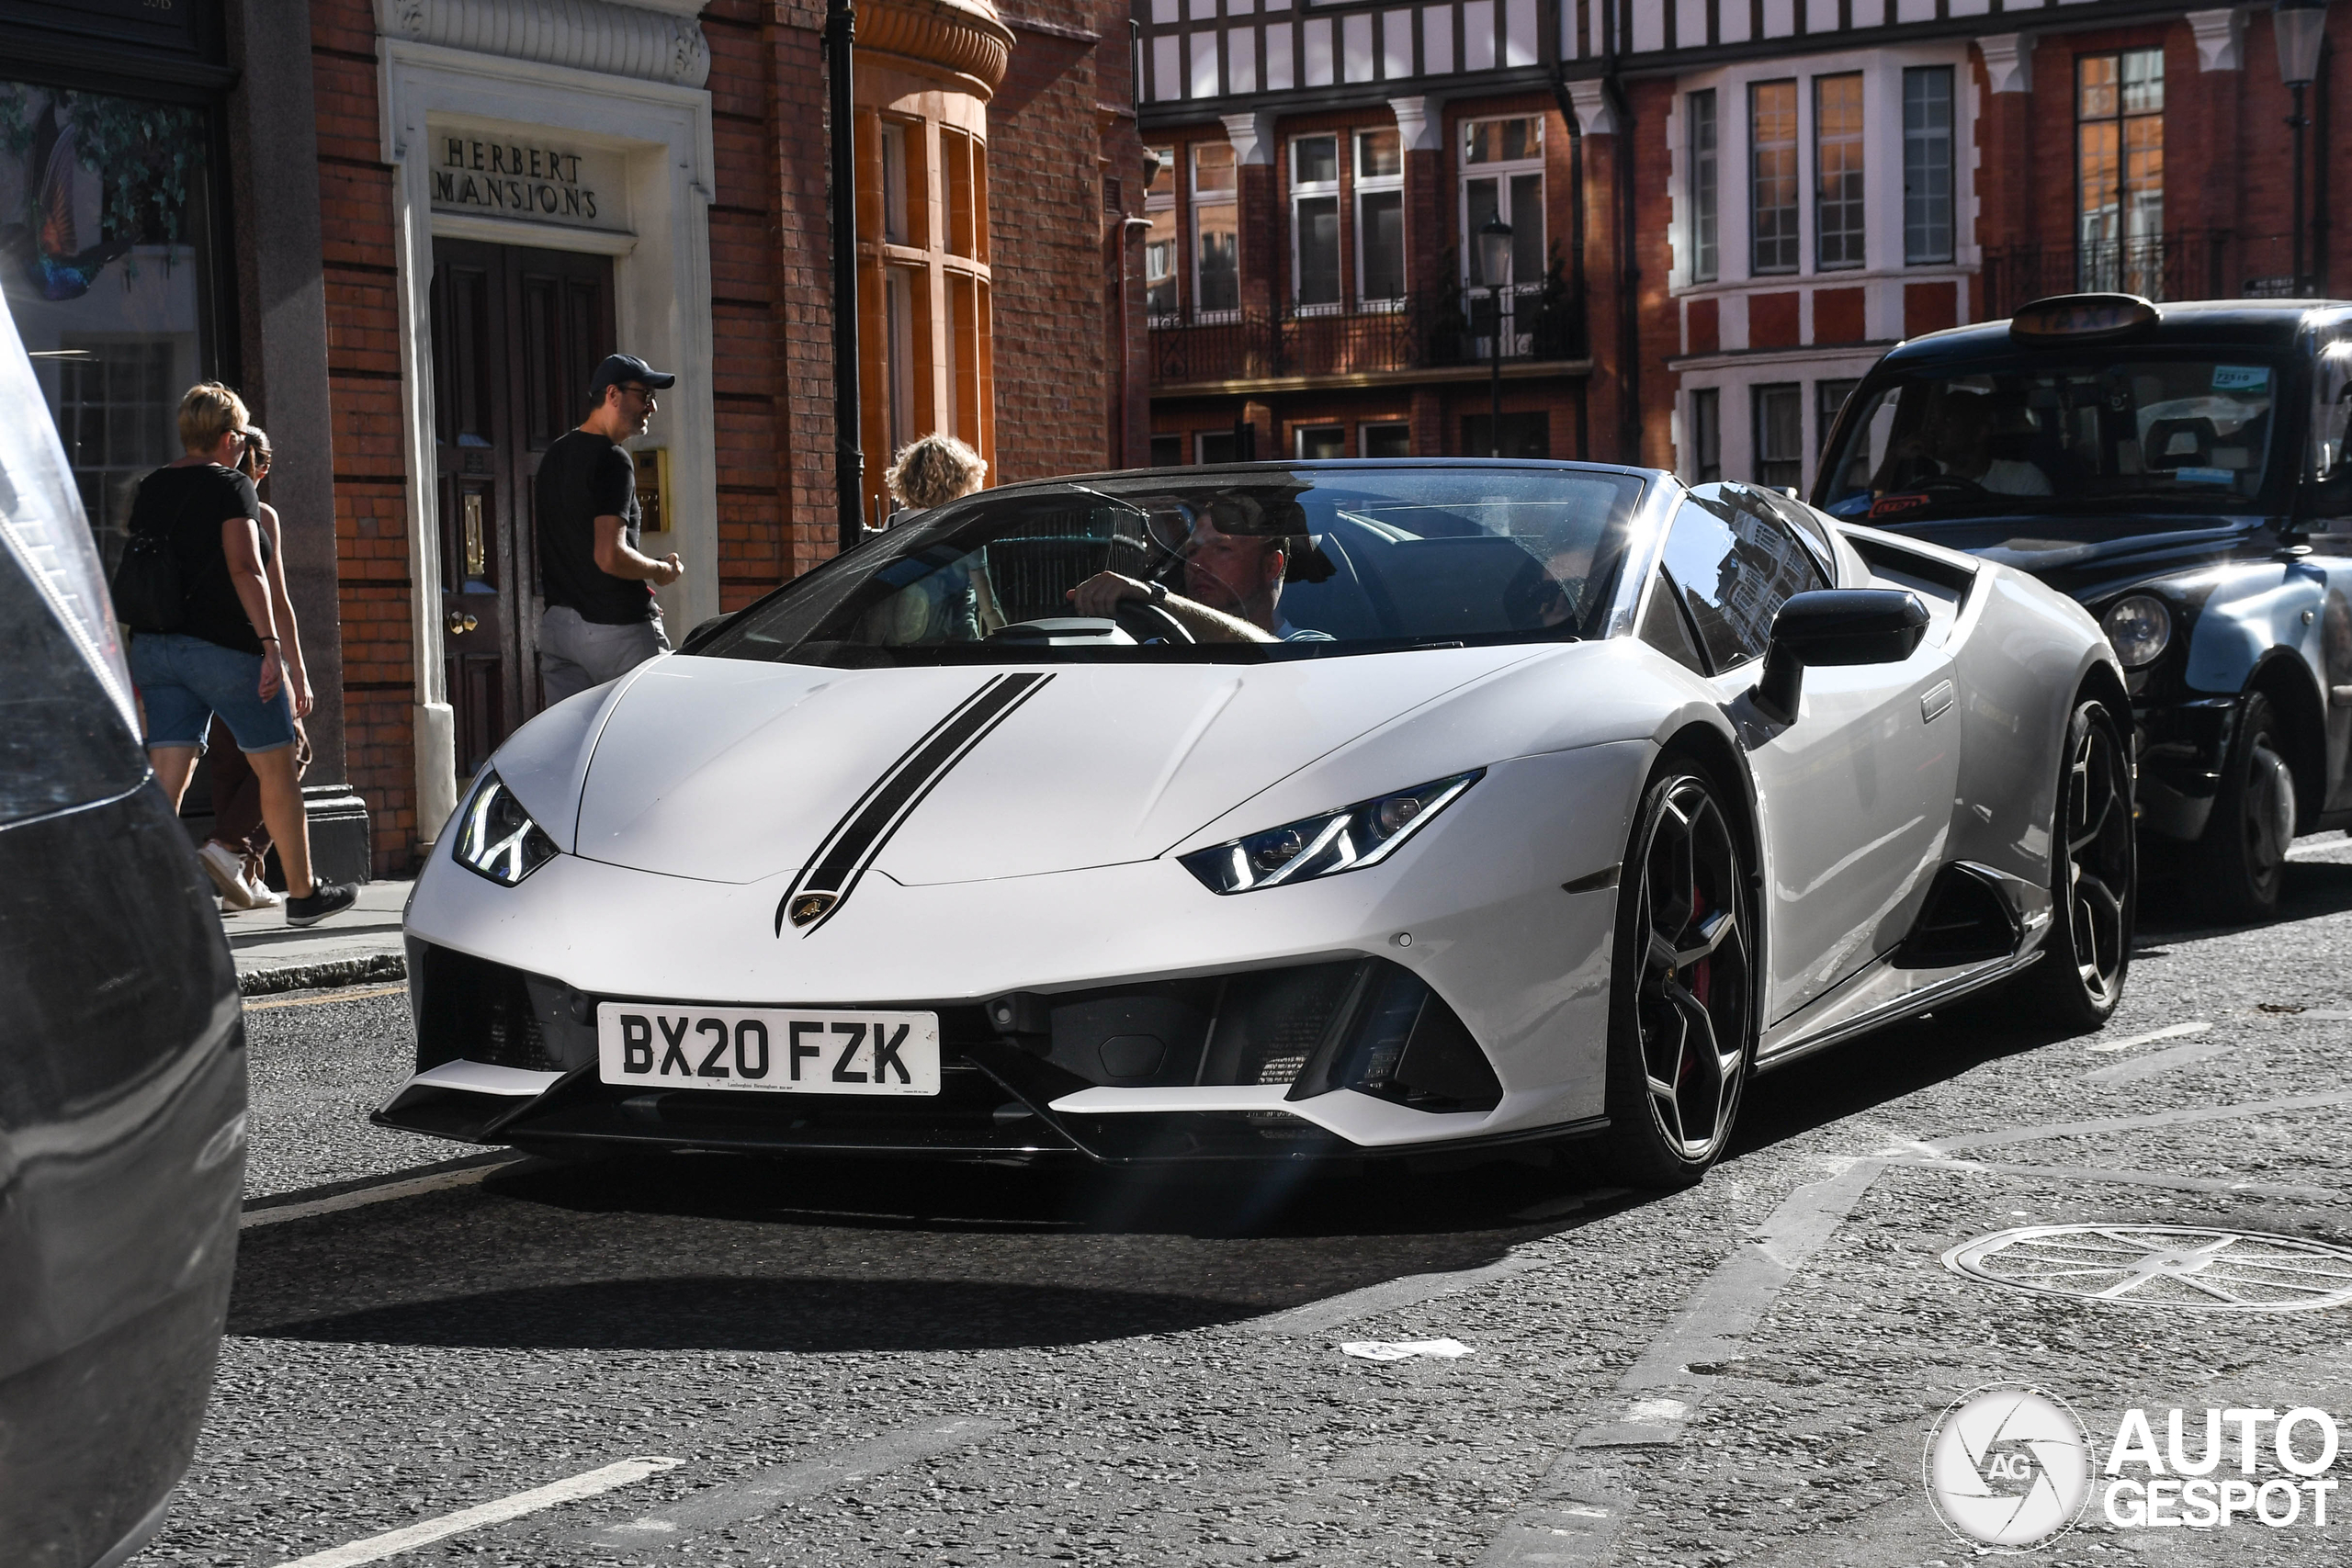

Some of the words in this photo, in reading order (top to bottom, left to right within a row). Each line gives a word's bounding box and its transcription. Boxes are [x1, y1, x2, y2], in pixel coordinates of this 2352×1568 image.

[446, 137, 582, 184] HERBERT
[435, 171, 597, 220] MANSIONS
[2037, 307, 2120, 330] TAXI
[620, 1014, 770, 1079] BX20
[789, 1021, 910, 1084] FZK
